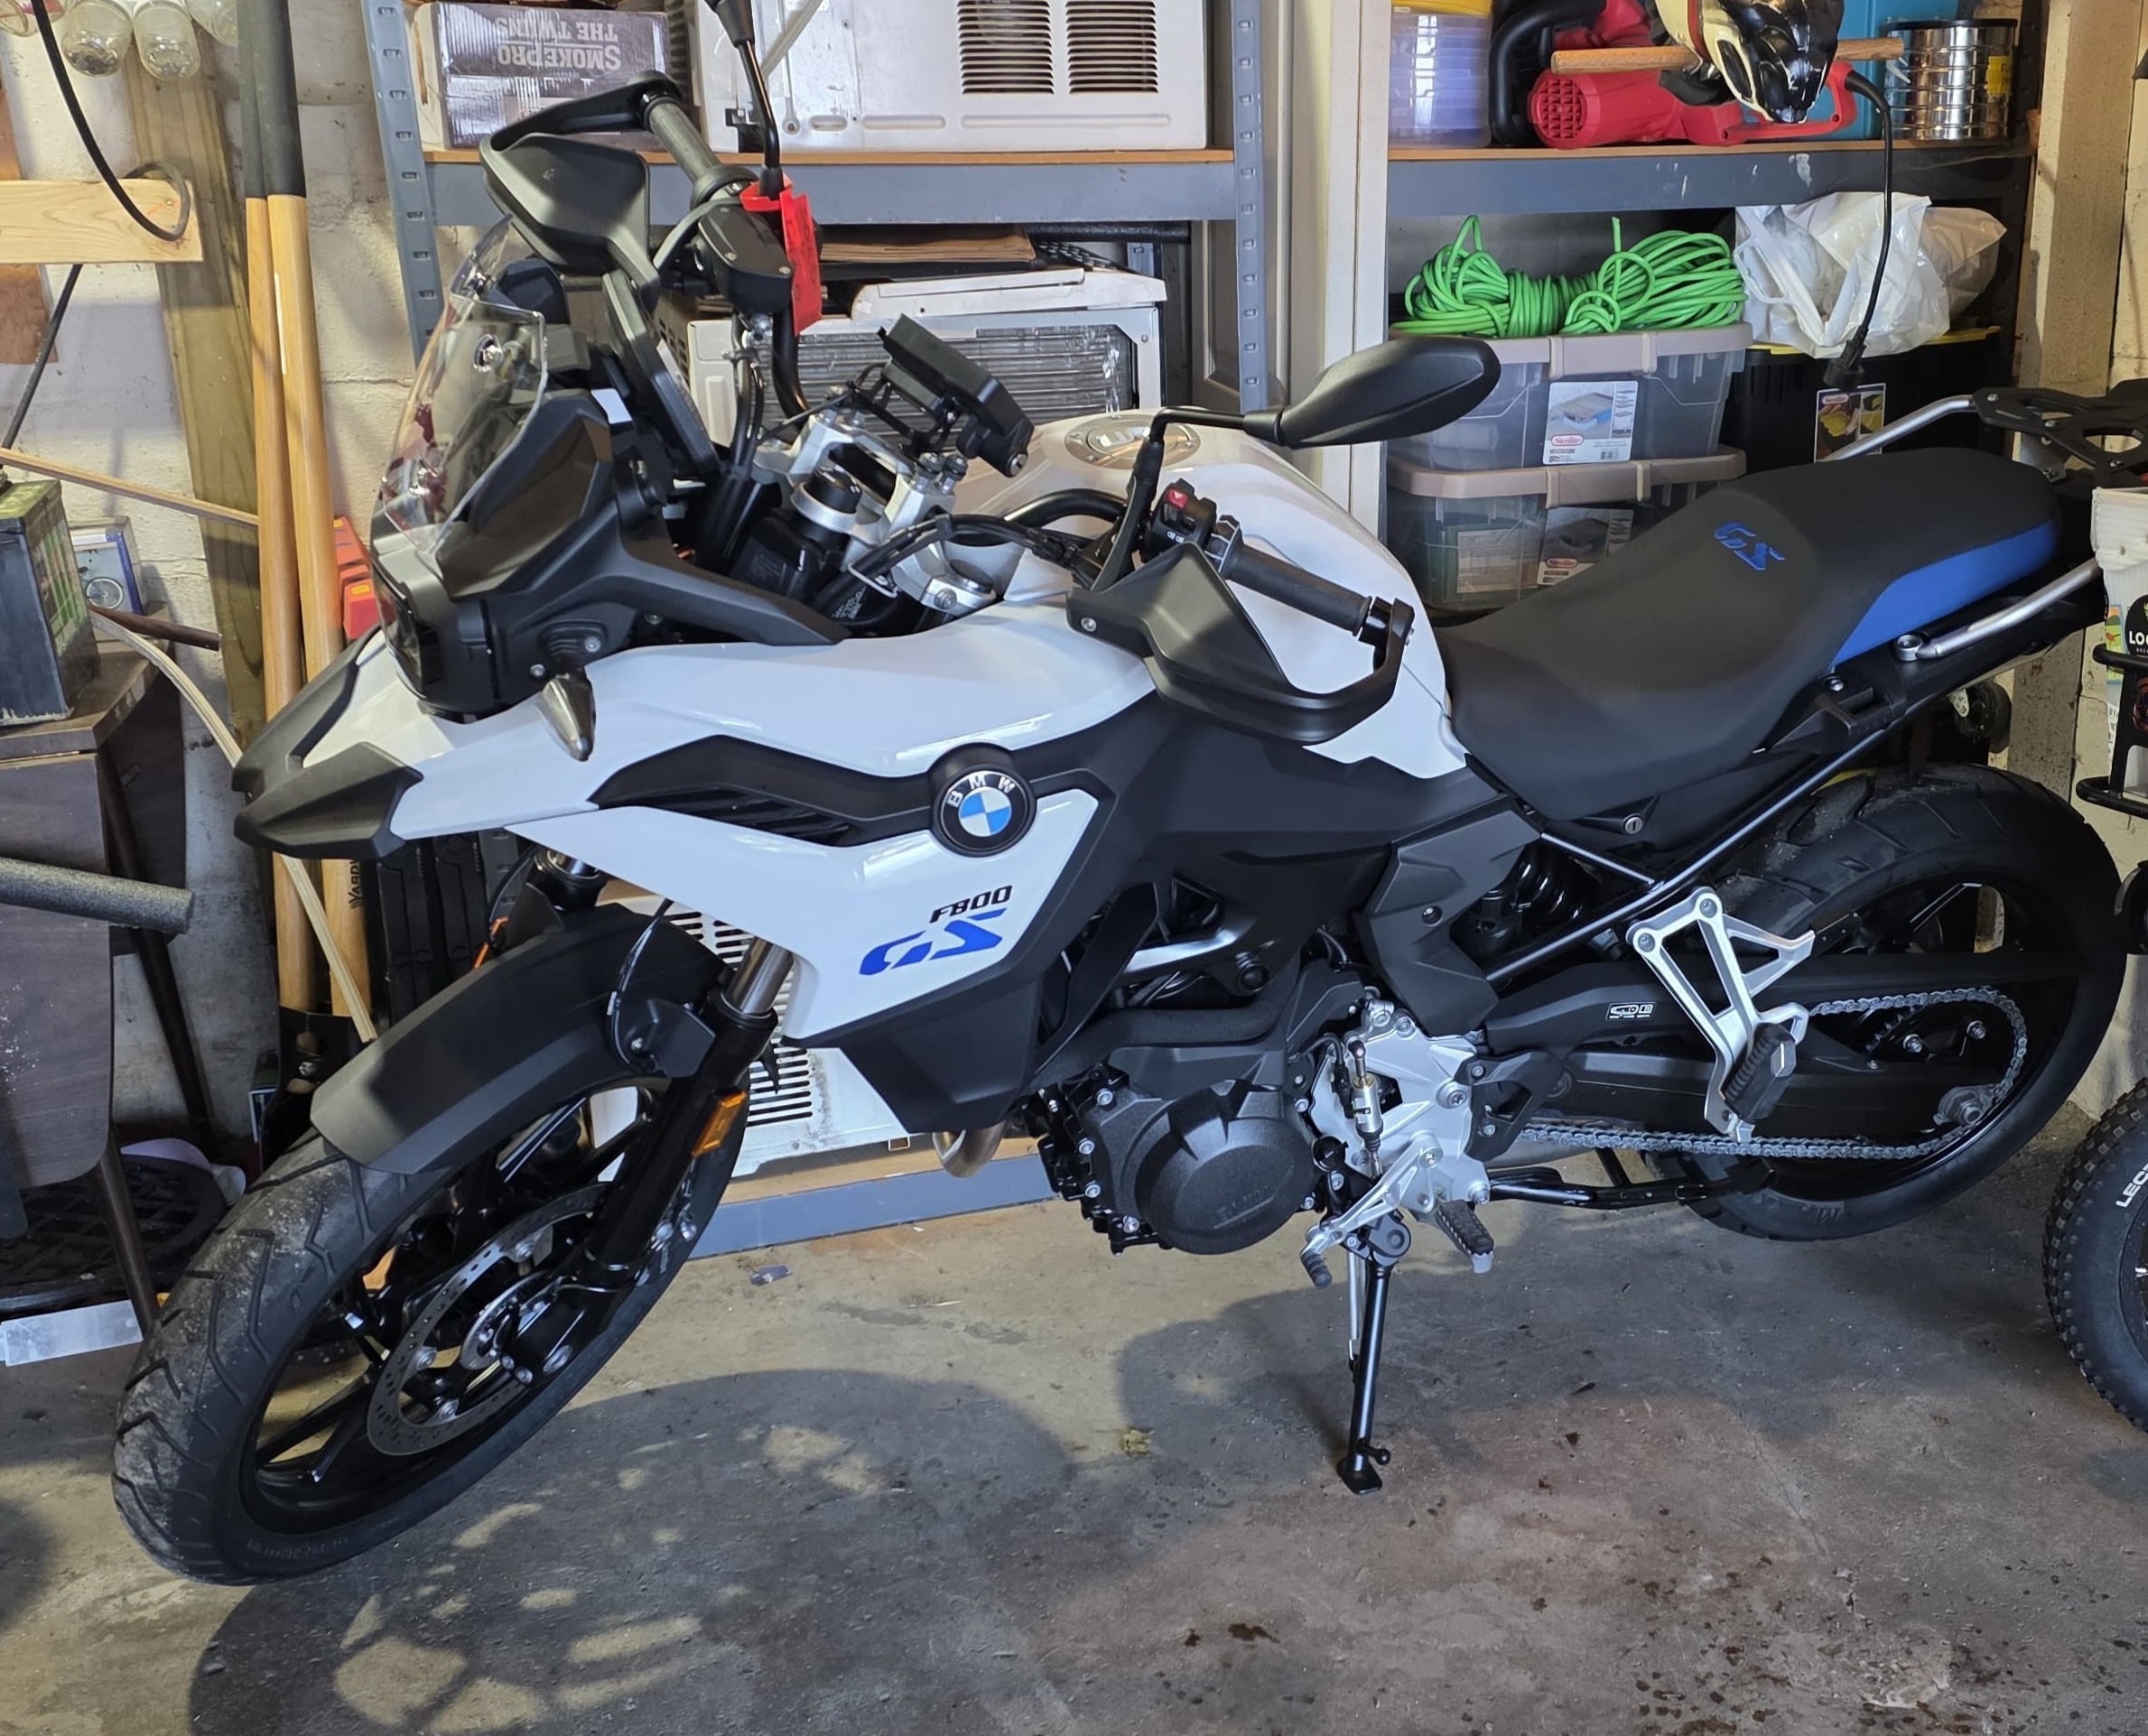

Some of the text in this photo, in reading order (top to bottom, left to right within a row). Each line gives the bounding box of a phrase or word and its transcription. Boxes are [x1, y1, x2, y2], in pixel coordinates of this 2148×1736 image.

[496, 17, 618, 42] THE TWINS
[497, 45, 621, 70] SMOKEPRO
[1714, 521, 1786, 571] GS
[2129, 630, 2148, 646] LO
[946, 774, 1016, 808] BMW
[929, 885, 1013, 924] F800
[859, 907, 1008, 976] GS
